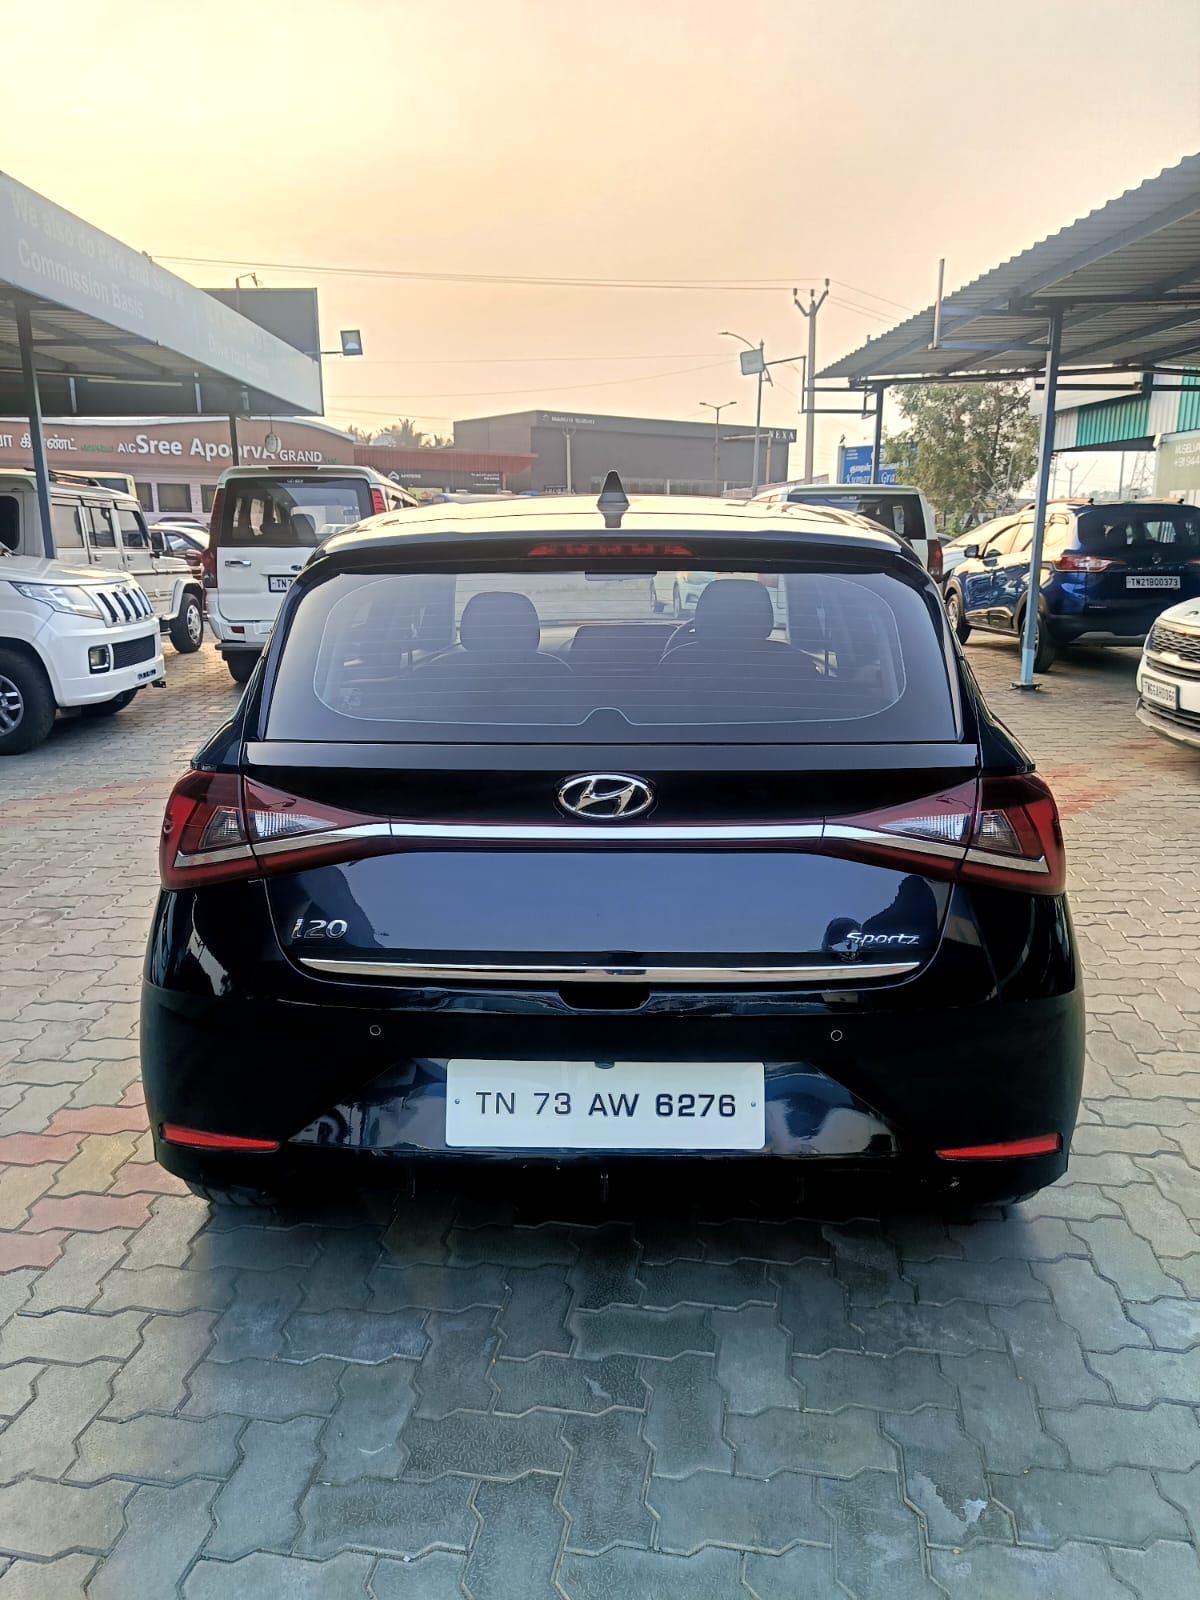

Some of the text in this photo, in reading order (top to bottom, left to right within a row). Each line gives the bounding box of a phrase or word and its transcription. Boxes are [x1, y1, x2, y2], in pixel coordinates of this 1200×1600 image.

[18, 238, 144, 319] Commission Basis
[136, 434, 182, 455] Sree
[279, 450, 322, 463] GRAND
[291, 918, 348, 938] i20
[846, 932, 920, 947] Sportz
[476, 1091, 736, 1117] TN 73 AW 6276
